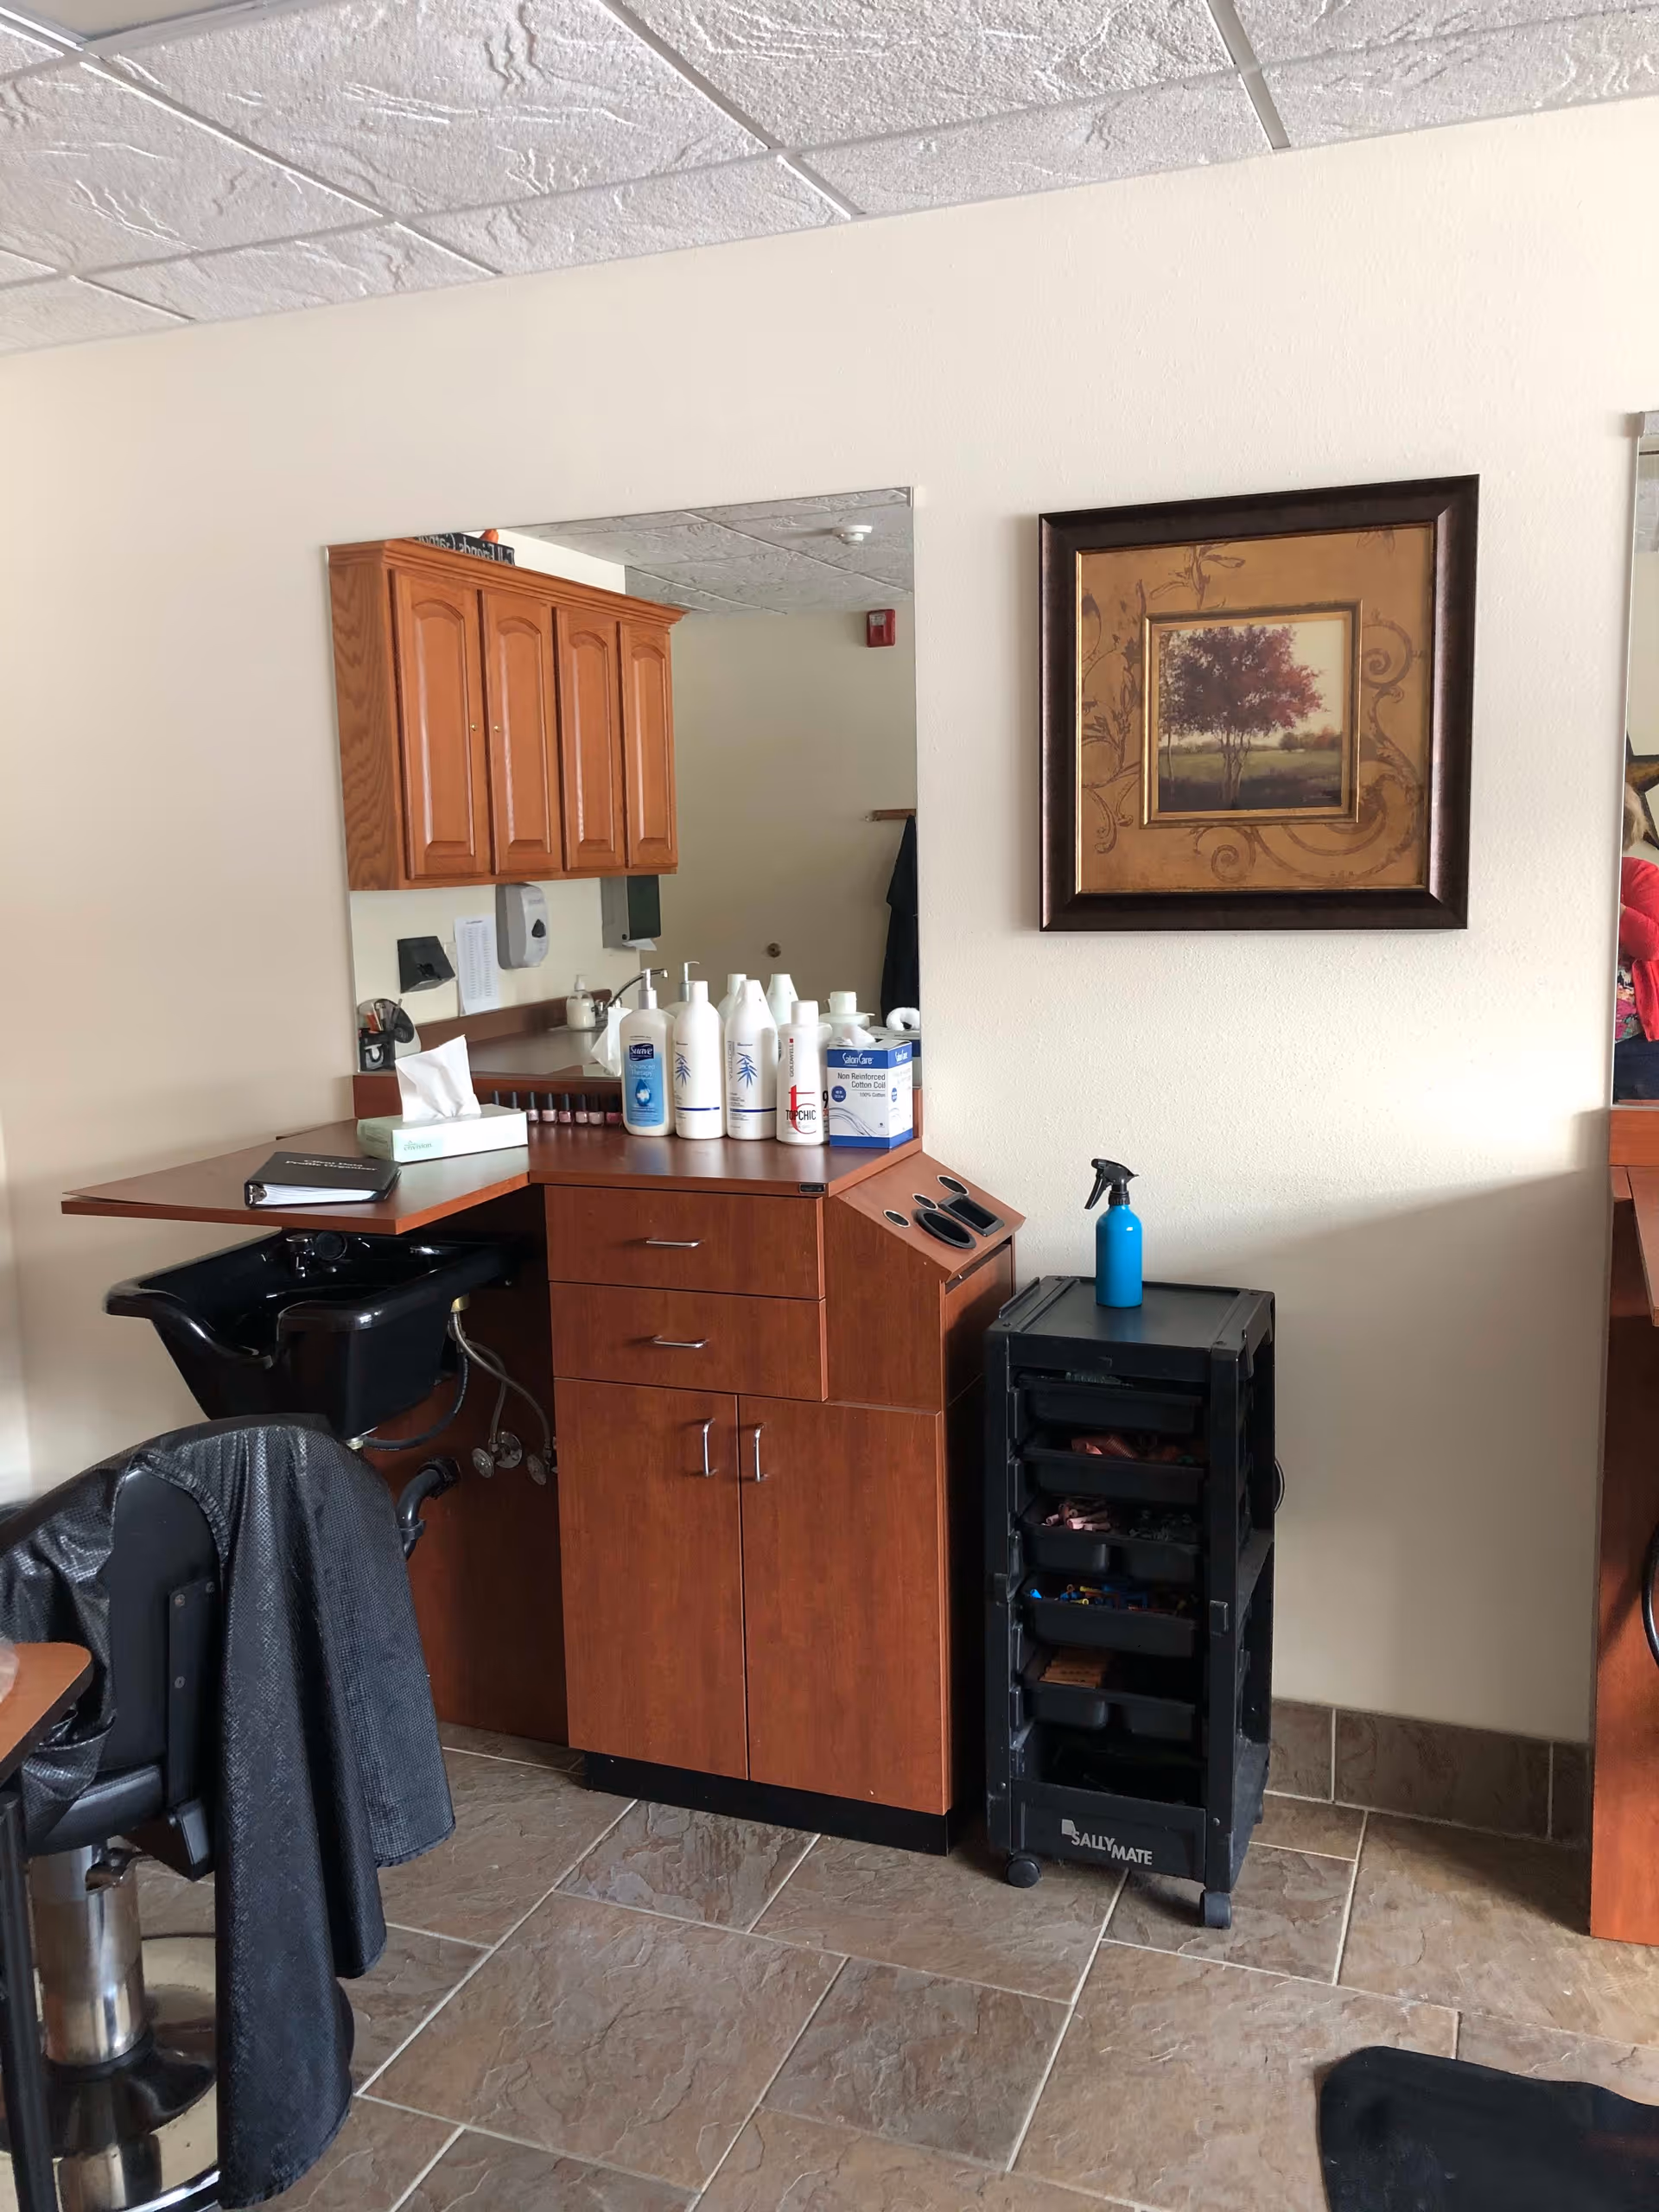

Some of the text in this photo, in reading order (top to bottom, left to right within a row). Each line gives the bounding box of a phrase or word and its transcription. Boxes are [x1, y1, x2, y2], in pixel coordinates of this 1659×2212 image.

[631, 1046, 652, 1055] Suave
[842, 1052, 873, 1065] SalonCare
[785, 1109, 817, 1121] TOPCHIC
